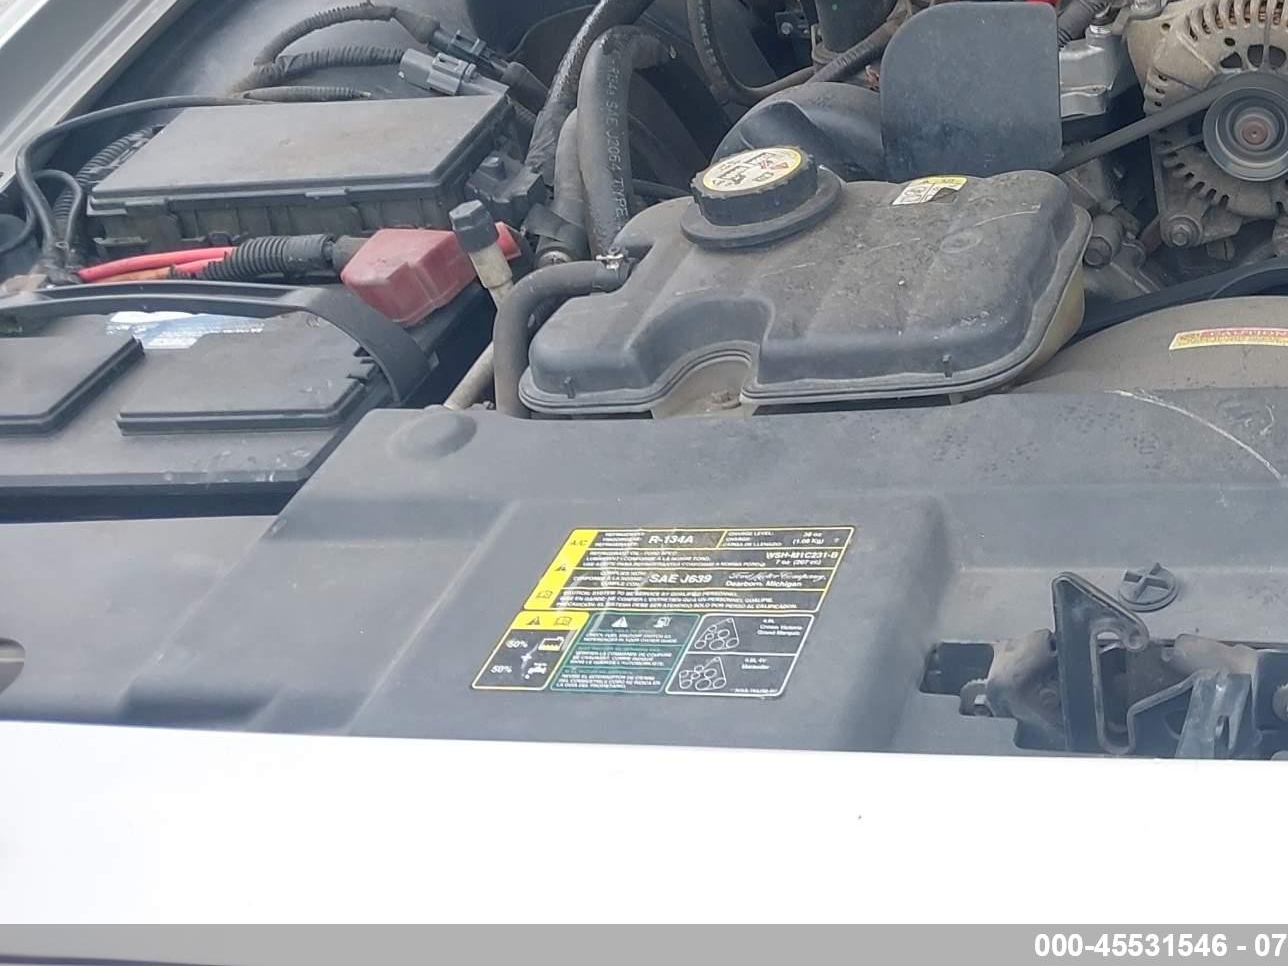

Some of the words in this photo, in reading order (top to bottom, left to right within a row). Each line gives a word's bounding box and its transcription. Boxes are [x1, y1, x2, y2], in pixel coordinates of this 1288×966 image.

[605, 101, 619, 129] SAE
[606, 131, 622, 171] J2064
[612, 177, 629, 218] TYPE
[648, 535, 694, 544] R-134A
[649, 574, 679, 583] SAE
[680, 574, 713, 583] J639
